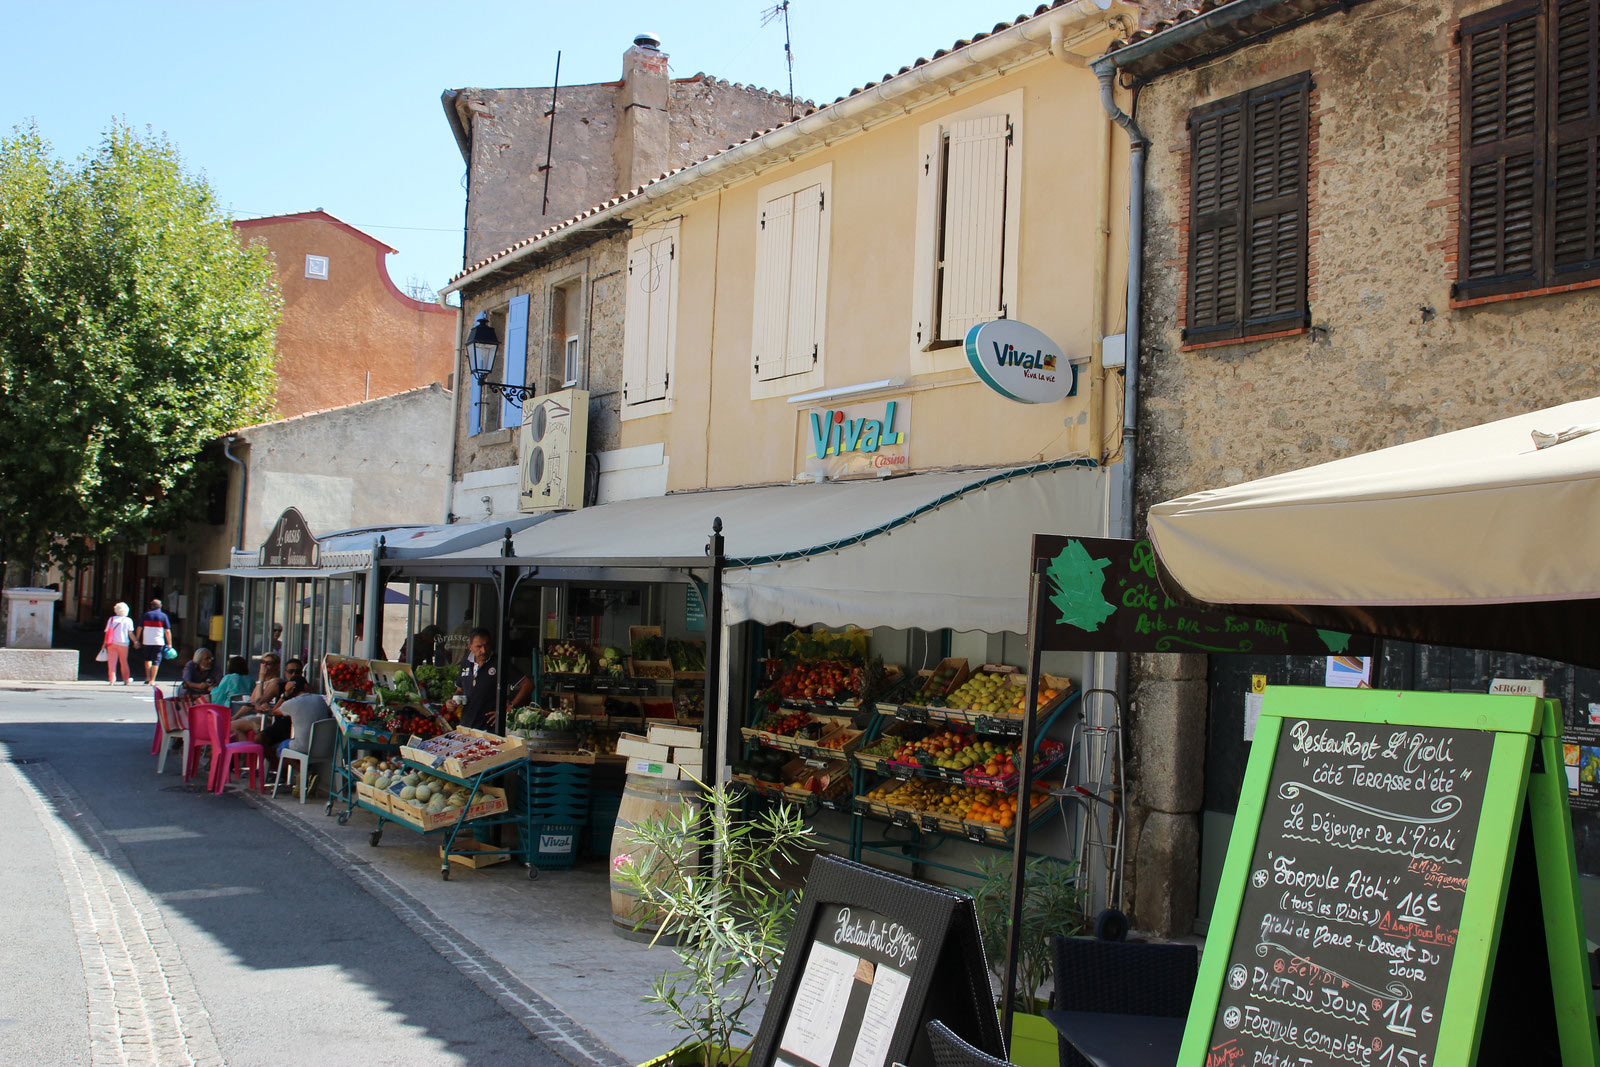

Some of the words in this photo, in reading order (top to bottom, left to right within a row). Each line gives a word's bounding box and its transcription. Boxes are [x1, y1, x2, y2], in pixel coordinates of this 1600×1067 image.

[874, 453, 905, 469] Casino
[1492, 684, 1527, 693] SERGIO
[1283, 803, 1304, 830] Le
[1408, 858, 1418, 869] Le
[1317, 898, 1331, 915] les
[1296, 920, 1310, 939] de
[1253, 1045, 1280, 1067] plat
